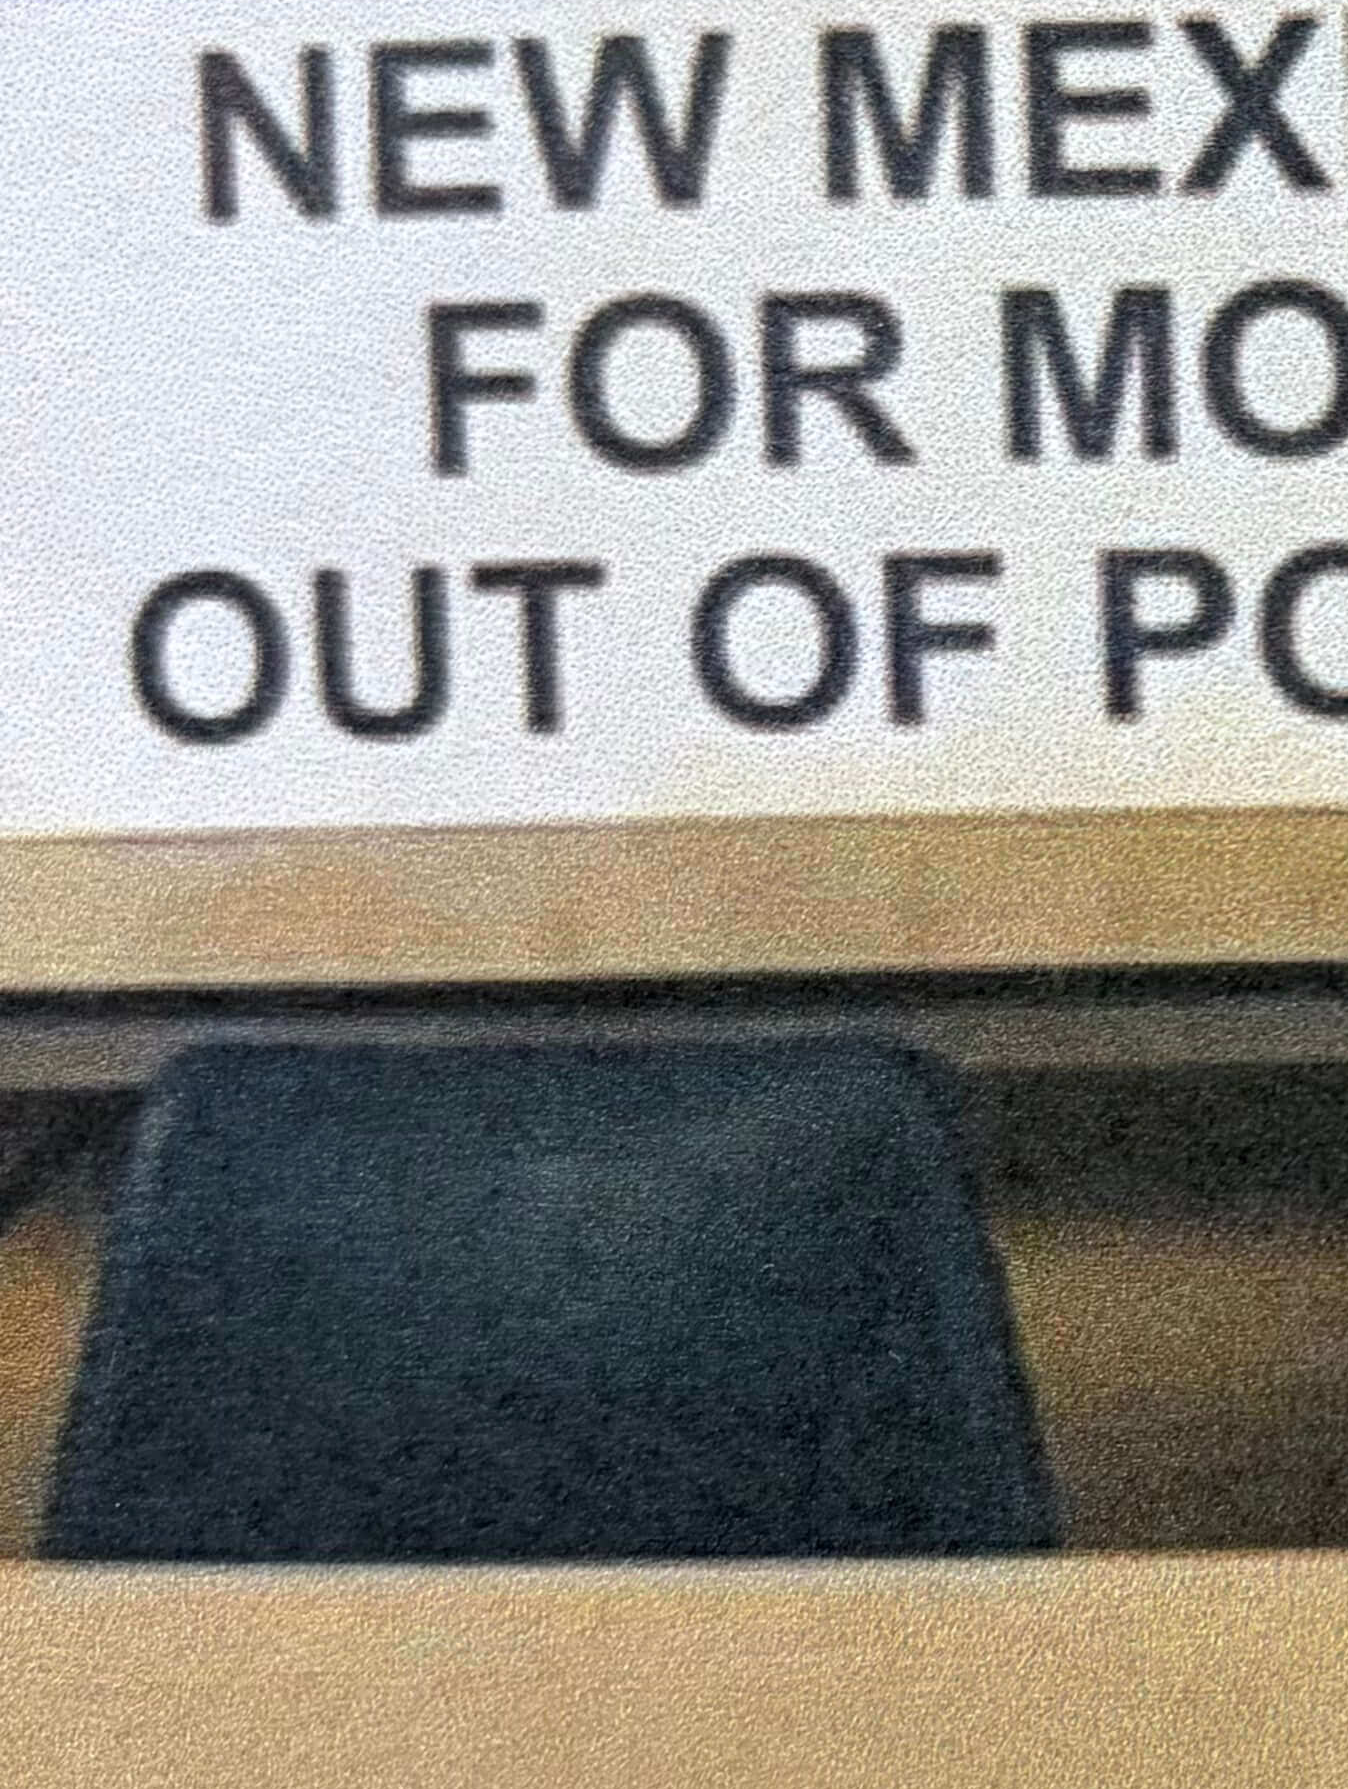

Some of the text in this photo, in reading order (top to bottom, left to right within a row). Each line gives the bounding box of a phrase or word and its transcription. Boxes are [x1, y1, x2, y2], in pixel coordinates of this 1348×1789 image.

[196, 31, 733, 223] NEW
[426, 287, 916, 478] FOR
[130, 558, 609, 746] OUT
[690, 550, 1002, 731] OF
